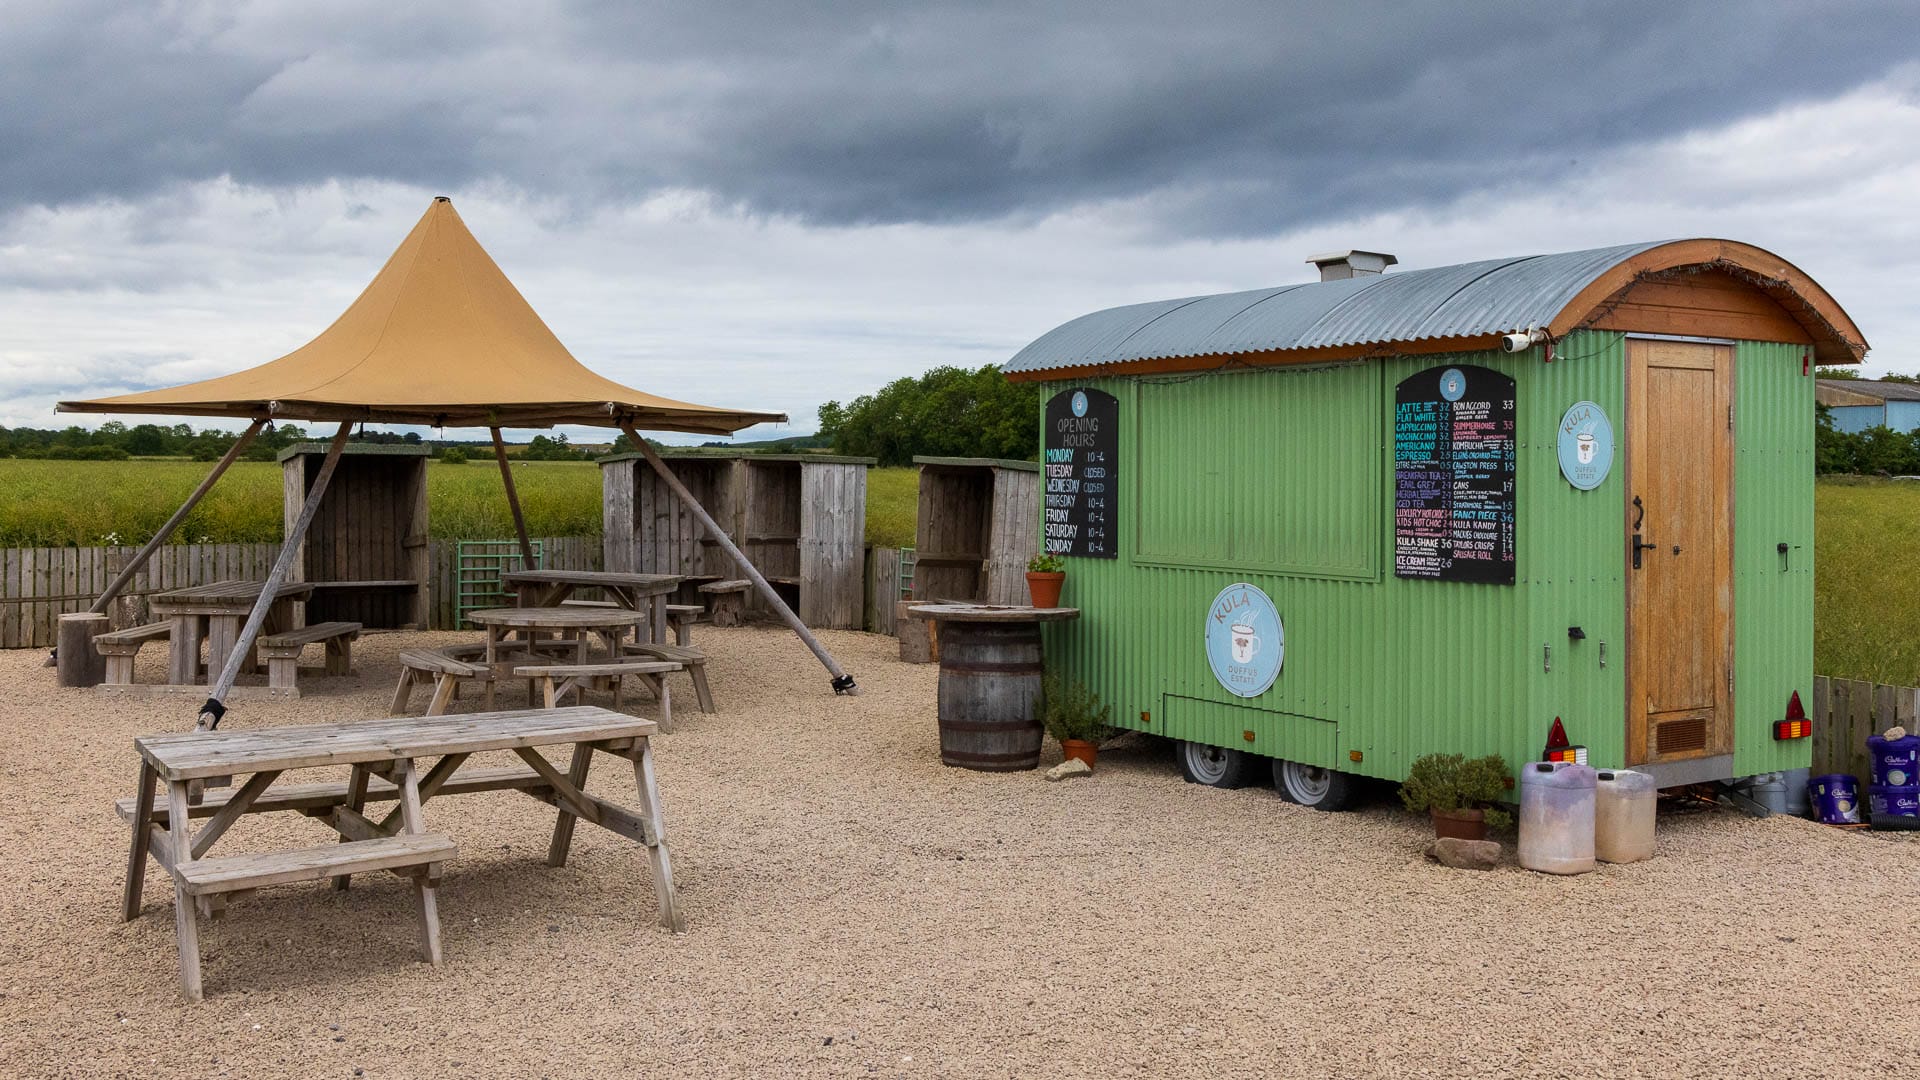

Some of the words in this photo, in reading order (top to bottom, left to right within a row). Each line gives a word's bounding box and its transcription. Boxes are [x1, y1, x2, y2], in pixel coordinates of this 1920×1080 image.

[1396, 402, 1421, 412] LATTE
[1453, 402, 1465, 411] BON
[1466, 402, 1490, 410] ACCORD
[1396, 413, 1412, 422] FLAT
[1415, 412, 1436, 421] WHITE
[1565, 408, 1591, 434] KULA
[1058, 418, 1099, 432] OPENING
[1396, 422, 1437, 431] CAPPUCCINO
[1454, 422, 1496, 430] SUMMERHOUSE
[1063, 433, 1096, 447] HOURS
[1396, 442, 1436, 450] AMERICANO
[1453, 442, 1484, 450] KOMBUCHA
[1046, 448, 1074, 463] MONDAY
[1396, 451, 1432, 460] ESPRESSO
[1453, 461, 1478, 470] CAWSTON
[1480, 461, 1498, 470] PRESS
[1046, 464, 1073, 478] TUESDAY
[1084, 468, 1106, 478] CLOSED
[1396, 471, 1428, 480] BREAKFAST
[1430, 472, 1441, 480] TEA
[1046, 478, 1080, 493] WEDNESDAY
[1083, 482, 1104, 492] CLOSED
[1400, 480, 1416, 488] EARL
[1417, 481, 1436, 489] GREY
[1453, 481, 1470, 490] CANS
[1396, 490, 1420, 498] HERBAL
[1046, 494, 1076, 507] THURSDAY
[1396, 500, 1410, 508] ICED
[1412, 500, 1425, 508] TEA
[1046, 508, 1068, 522] FRIDAY
[1396, 508, 1421, 518] LUXURY
[1453, 510, 1476, 520] FANCY
[1478, 511, 1498, 520] PIECE
[1396, 518, 1412, 526] KIDS
[1414, 518, 1425, 527] HOT
[1426, 519, 1442, 528] CHOC
[1453, 520, 1470, 529] KULA
[1472, 521, 1497, 530] KANDY
[1046, 524, 1078, 538] SATURDAY
[1474, 532, 1499, 540] CHOCOLATE
[1046, 539, 1072, 552] SUNDAY
[1396, 537, 1416, 546] KULA
[1417, 538, 1438, 548] SHAKE
[1453, 541, 1474, 549] TAYLORS
[1474, 542, 1494, 550] CRISPS
[1453, 550, 1476, 560] SAUSAGE
[1478, 551, 1492, 560] ROLL
[1396, 556, 1406, 566] ICE
[1406, 556, 1426, 566] CREAM
[1215, 592, 1250, 624] KULA
[1228, 666, 1258, 678] DUFFUS
[1231, 675, 1255, 684] ESTATE
